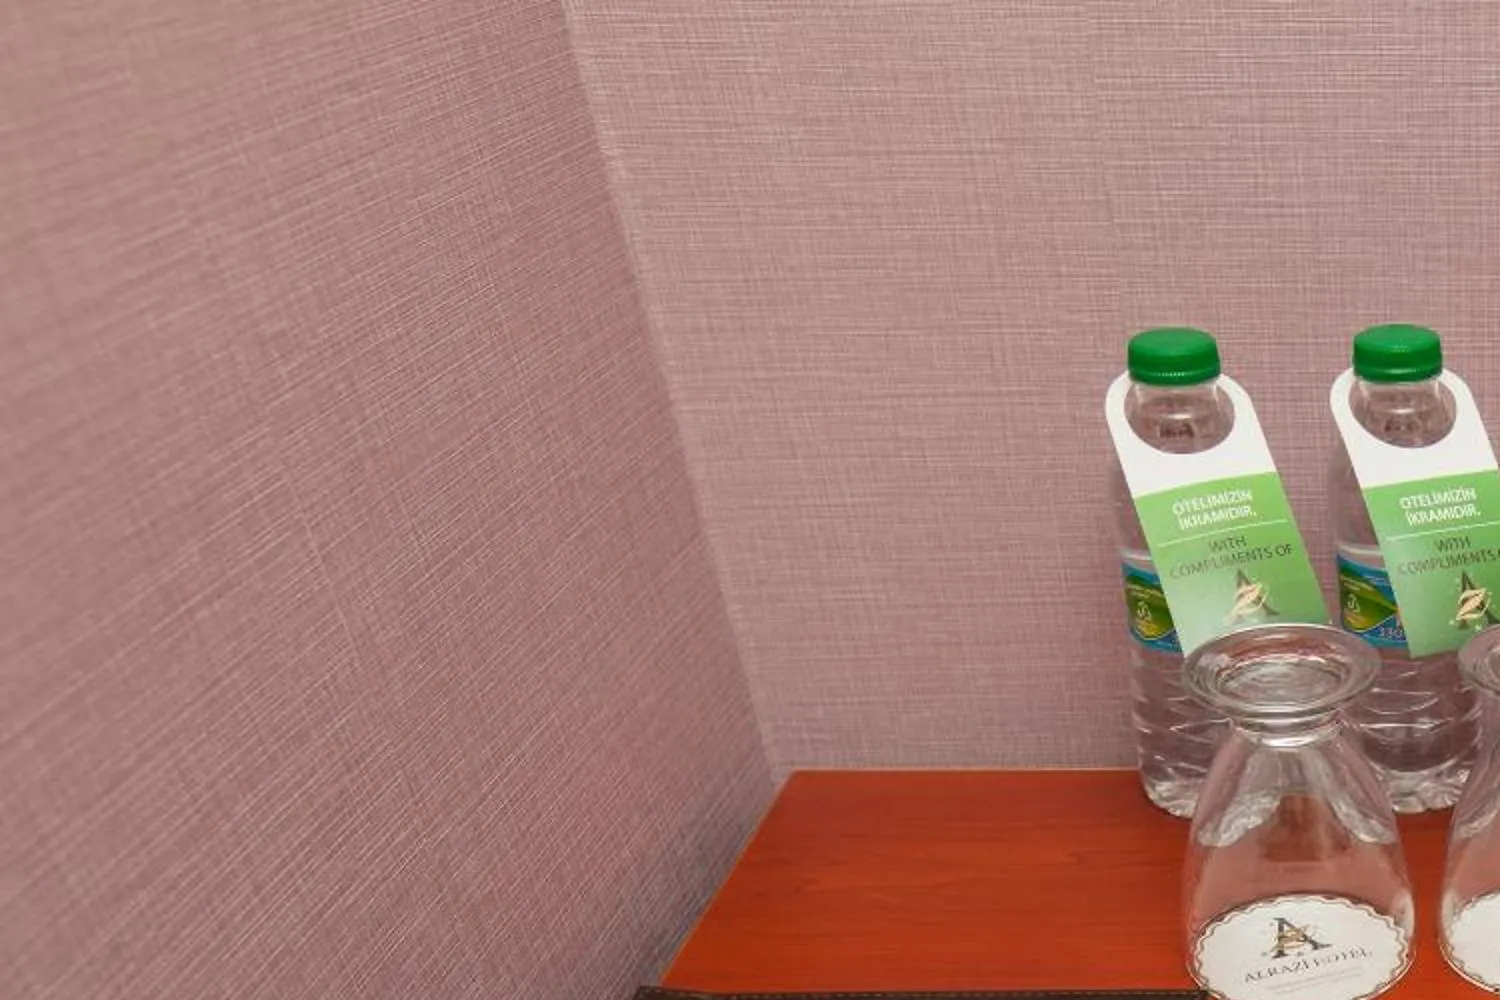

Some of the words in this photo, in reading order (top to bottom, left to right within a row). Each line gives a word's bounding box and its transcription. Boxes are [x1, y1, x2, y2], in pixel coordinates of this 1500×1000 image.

[1208, 535, 1247, 553] WITH
[1433, 535, 1471, 553] WITH
[1169, 547, 1273, 579] COMPLIMENTS
[1274, 543, 1293, 557] OF
[1396, 549, 1496, 576] COMPLIMENTS
